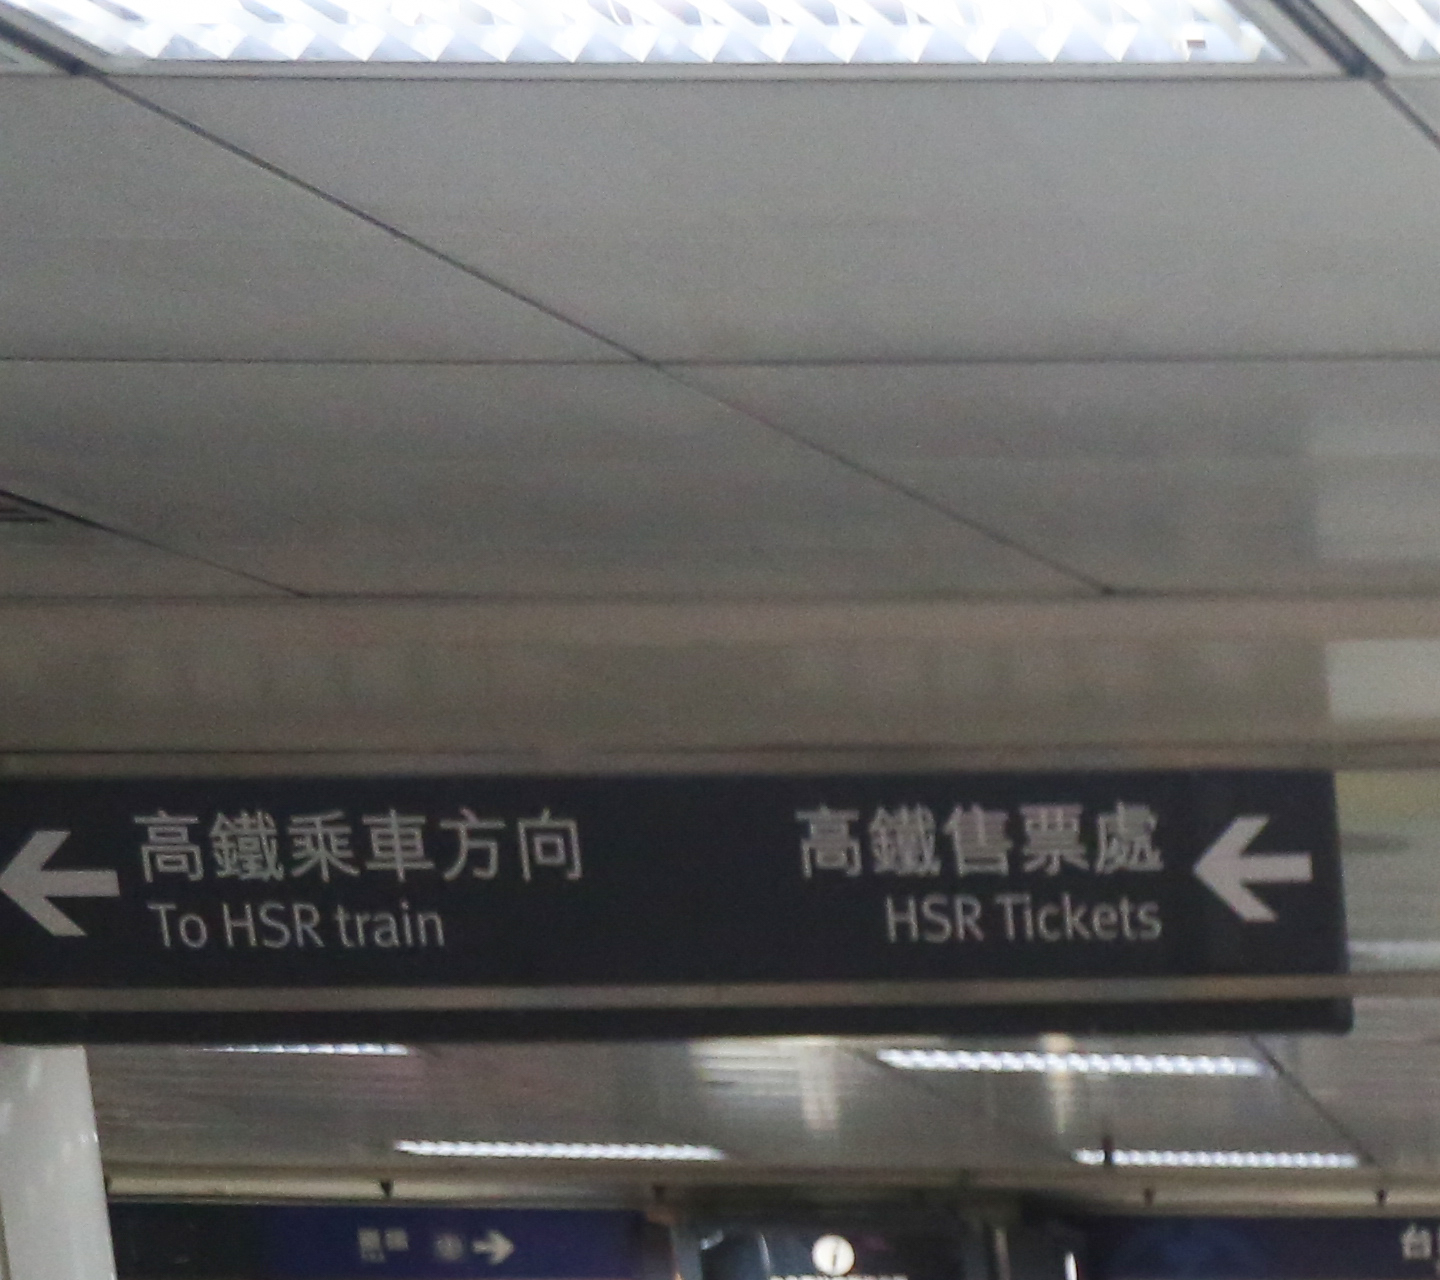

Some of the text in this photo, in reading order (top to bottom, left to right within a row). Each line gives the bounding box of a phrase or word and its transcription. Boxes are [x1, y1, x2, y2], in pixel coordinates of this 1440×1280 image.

[134, 807, 583, 883] 高鐵乘車方向
[795, 800, 1164, 878] 高鐵售票處
[147, 899, 445, 948] To HSR train
[886, 892, 1163, 943] HSR Tickets
